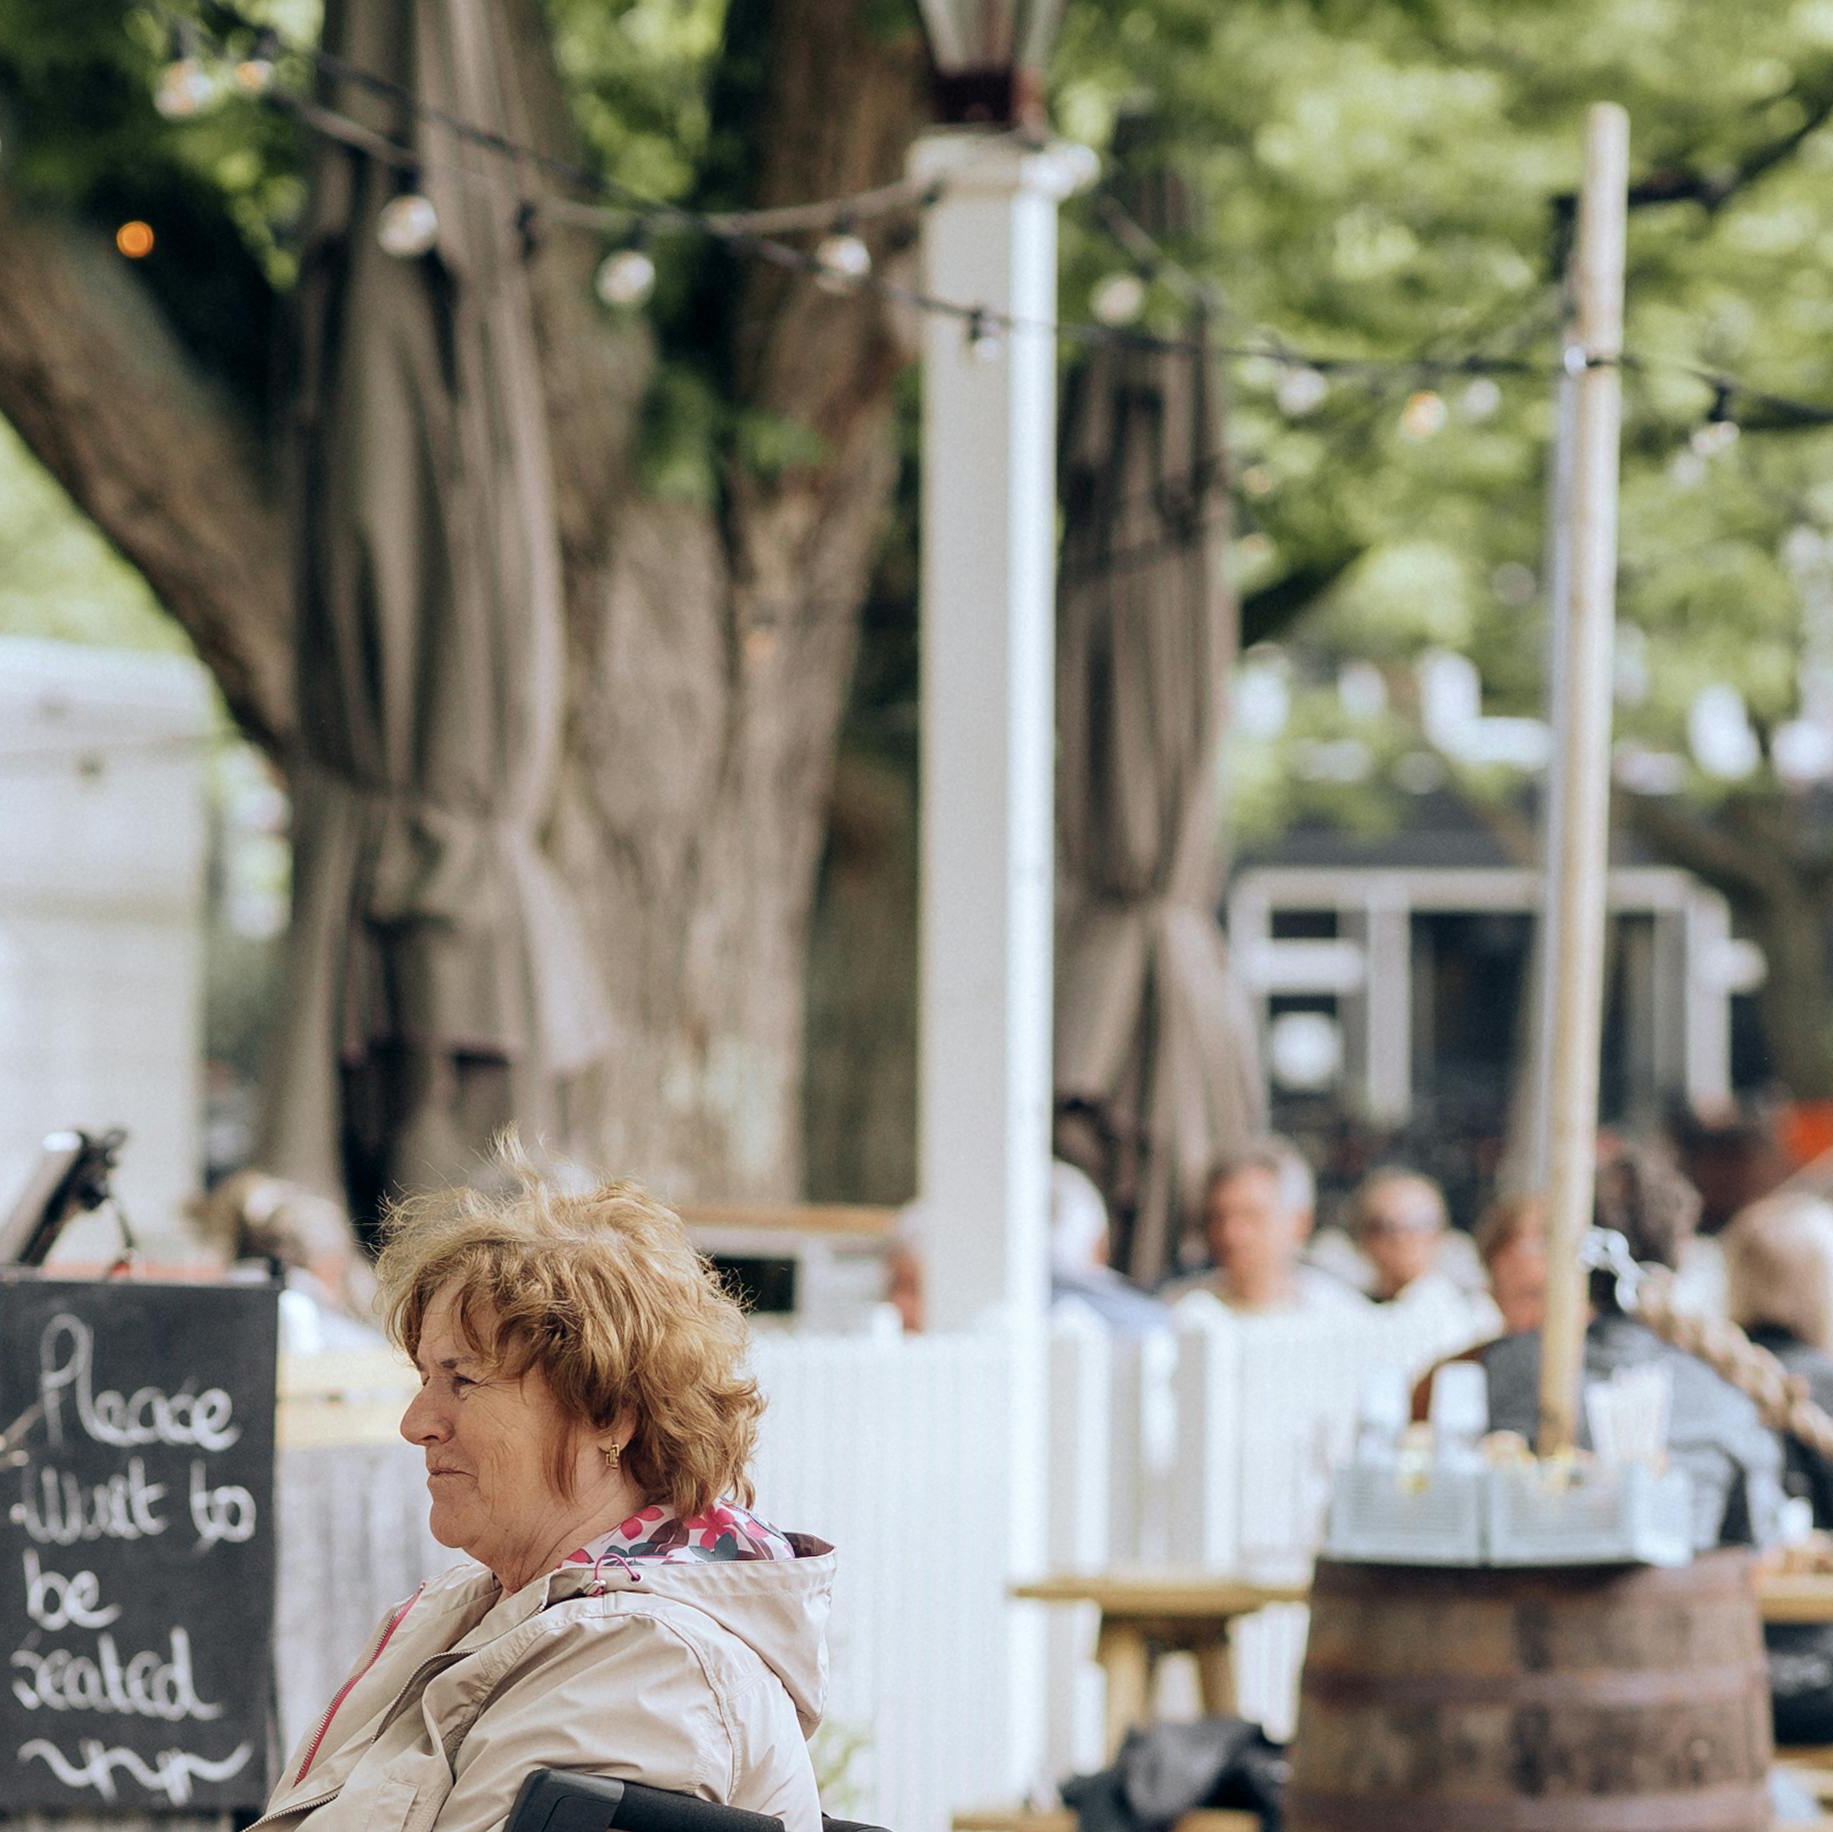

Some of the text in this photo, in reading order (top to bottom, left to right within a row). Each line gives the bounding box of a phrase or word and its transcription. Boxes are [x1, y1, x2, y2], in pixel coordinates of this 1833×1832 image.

[40, 1312, 242, 1452] Please
[190, 1458, 257, 1548] to
[23, 1548, 122, 1631] be
[10, 1627, 224, 1721] seated
